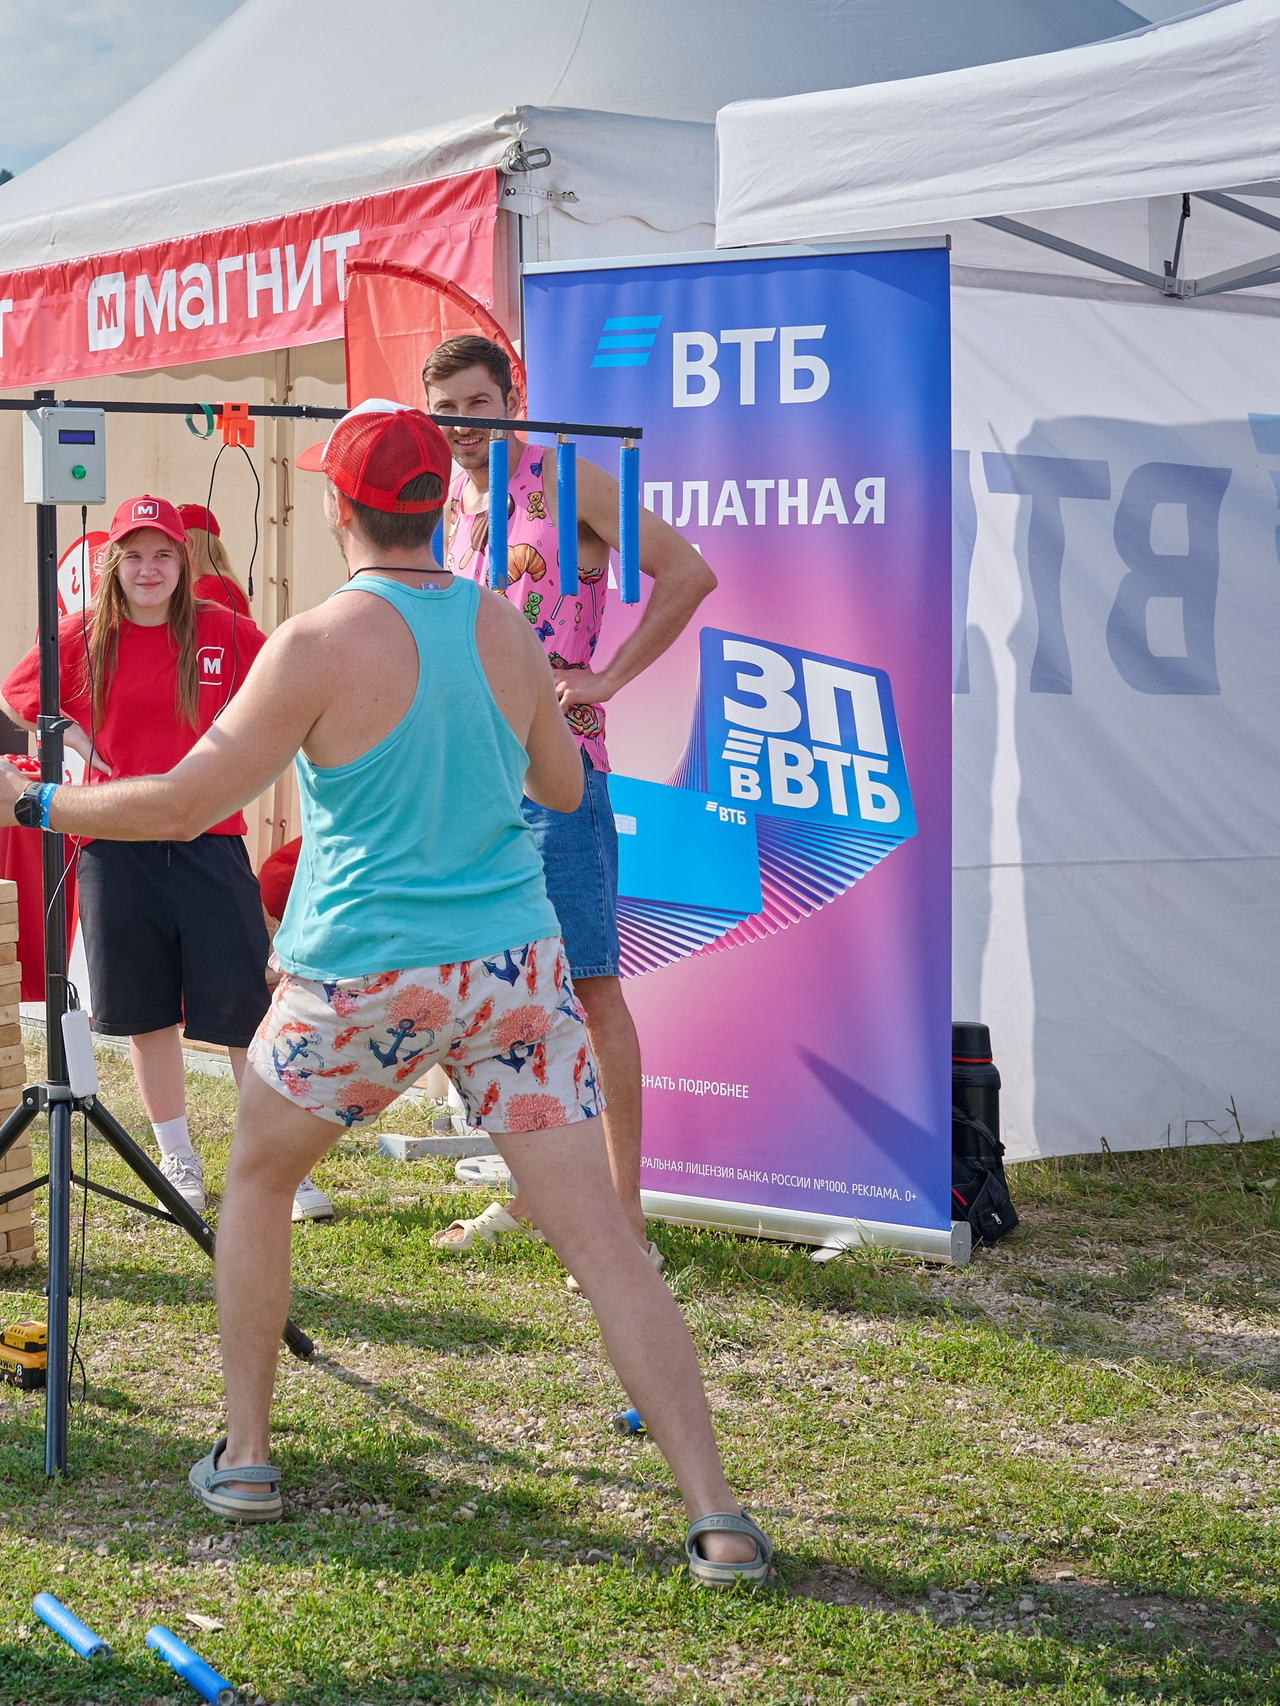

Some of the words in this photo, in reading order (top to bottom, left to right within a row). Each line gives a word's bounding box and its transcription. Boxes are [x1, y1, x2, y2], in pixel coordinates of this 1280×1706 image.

[672, 324, 831, 409] ВТБ
[641, 476, 887, 528] ПЛАТНАЯ
[722, 639, 889, 757] ЗП
[766, 736, 901, 824] ВТБ
[718, 806, 747, 825] ВТБ
[640, 1073, 676, 1091] ЗНАТЬ
[678, 1077, 749, 1099] ПОДРОБНЕЕ
[640, 1155, 684, 1173] РАЛЬНАЯ
[685, 1161, 735, 1179] ЛИЦЕНЗИЯ
[736, 1168, 770, 1184] БАНКА
[771, 1172, 811, 1189] РОССИИ
[813, 1178, 849, 1195] №1000.
[851, 1183, 903, 1201] РЕКЛАМА.
[904, 1190, 917, 1202] 0+
